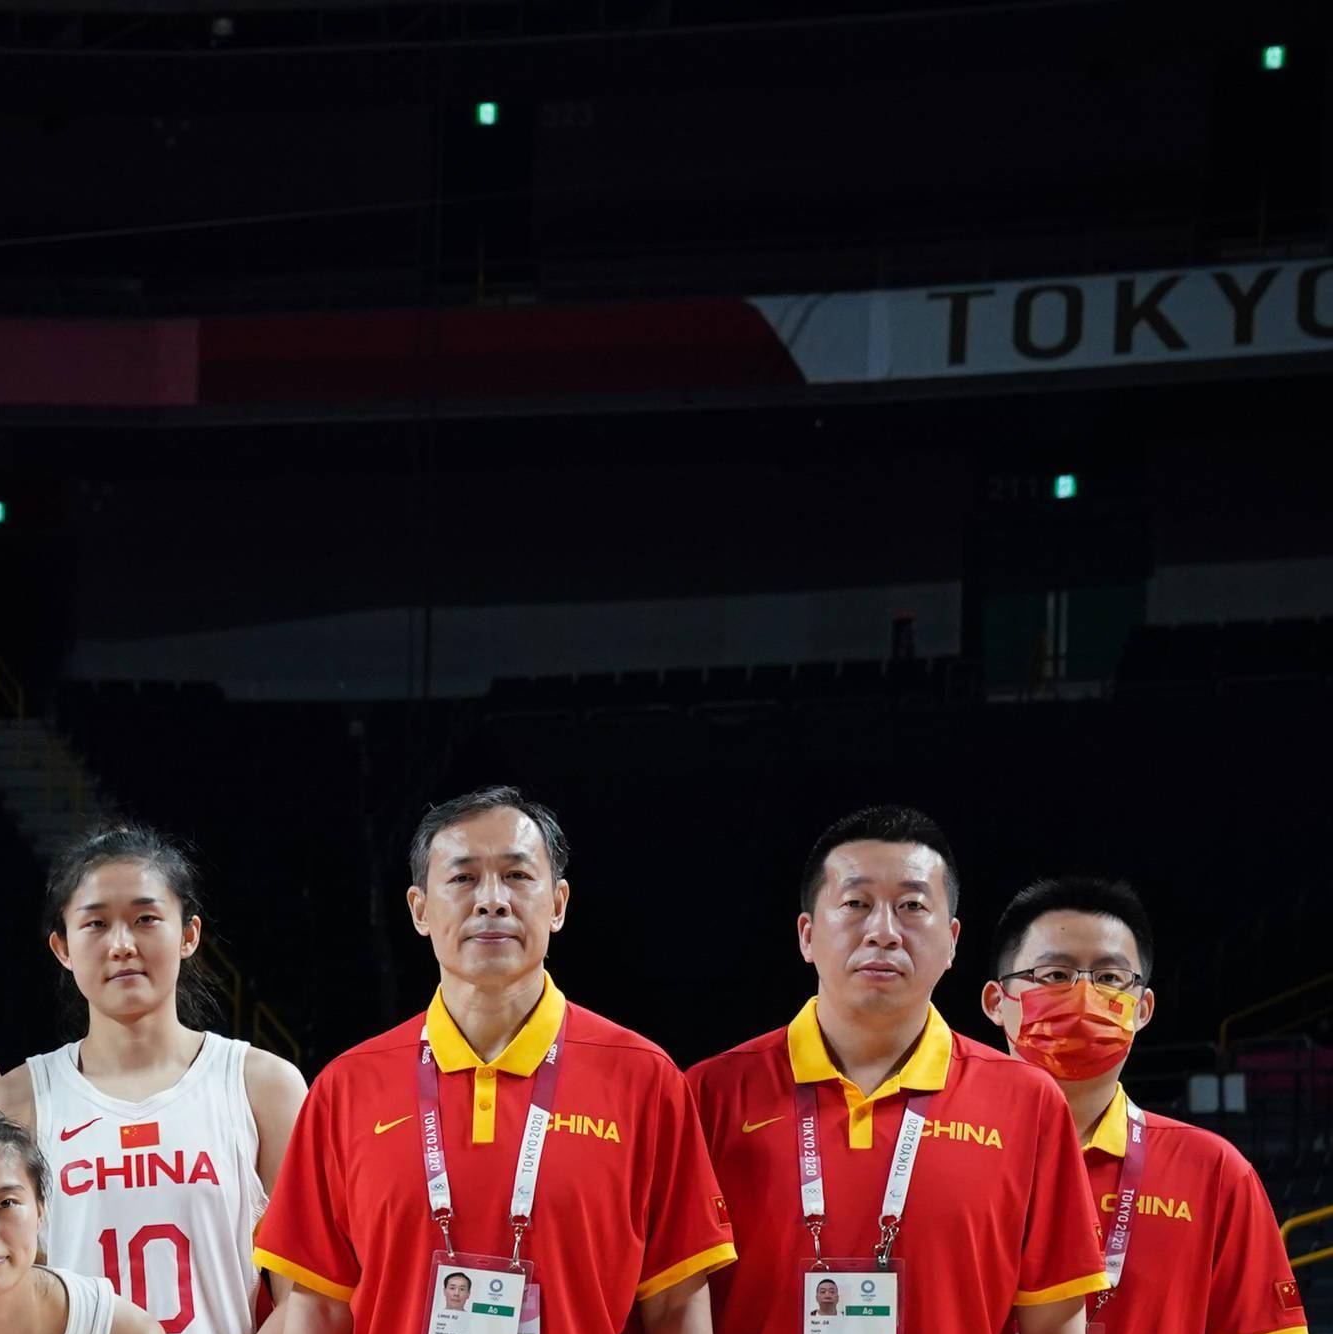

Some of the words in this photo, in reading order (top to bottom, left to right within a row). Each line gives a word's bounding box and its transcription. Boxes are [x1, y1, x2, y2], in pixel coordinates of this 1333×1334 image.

[424, 1110, 437, 1145] TOKYO
[522, 1139, 538, 1174] TOKYO
[530, 1113, 544, 1138] 2020
[802, 1116, 815, 1148] TOKYO
[427, 1145, 440, 1172] 2020
[804, 1150, 817, 1177] 2020
[894, 1143, 912, 1178] TOKYO
[904, 1118, 919, 1143] 2020
[60, 1150, 219, 1196] CHINA
[1117, 1189, 1134, 1224] TOKYO
[1111, 1224, 1126, 1250] 2020
[97, 1223, 194, 1334] 10
